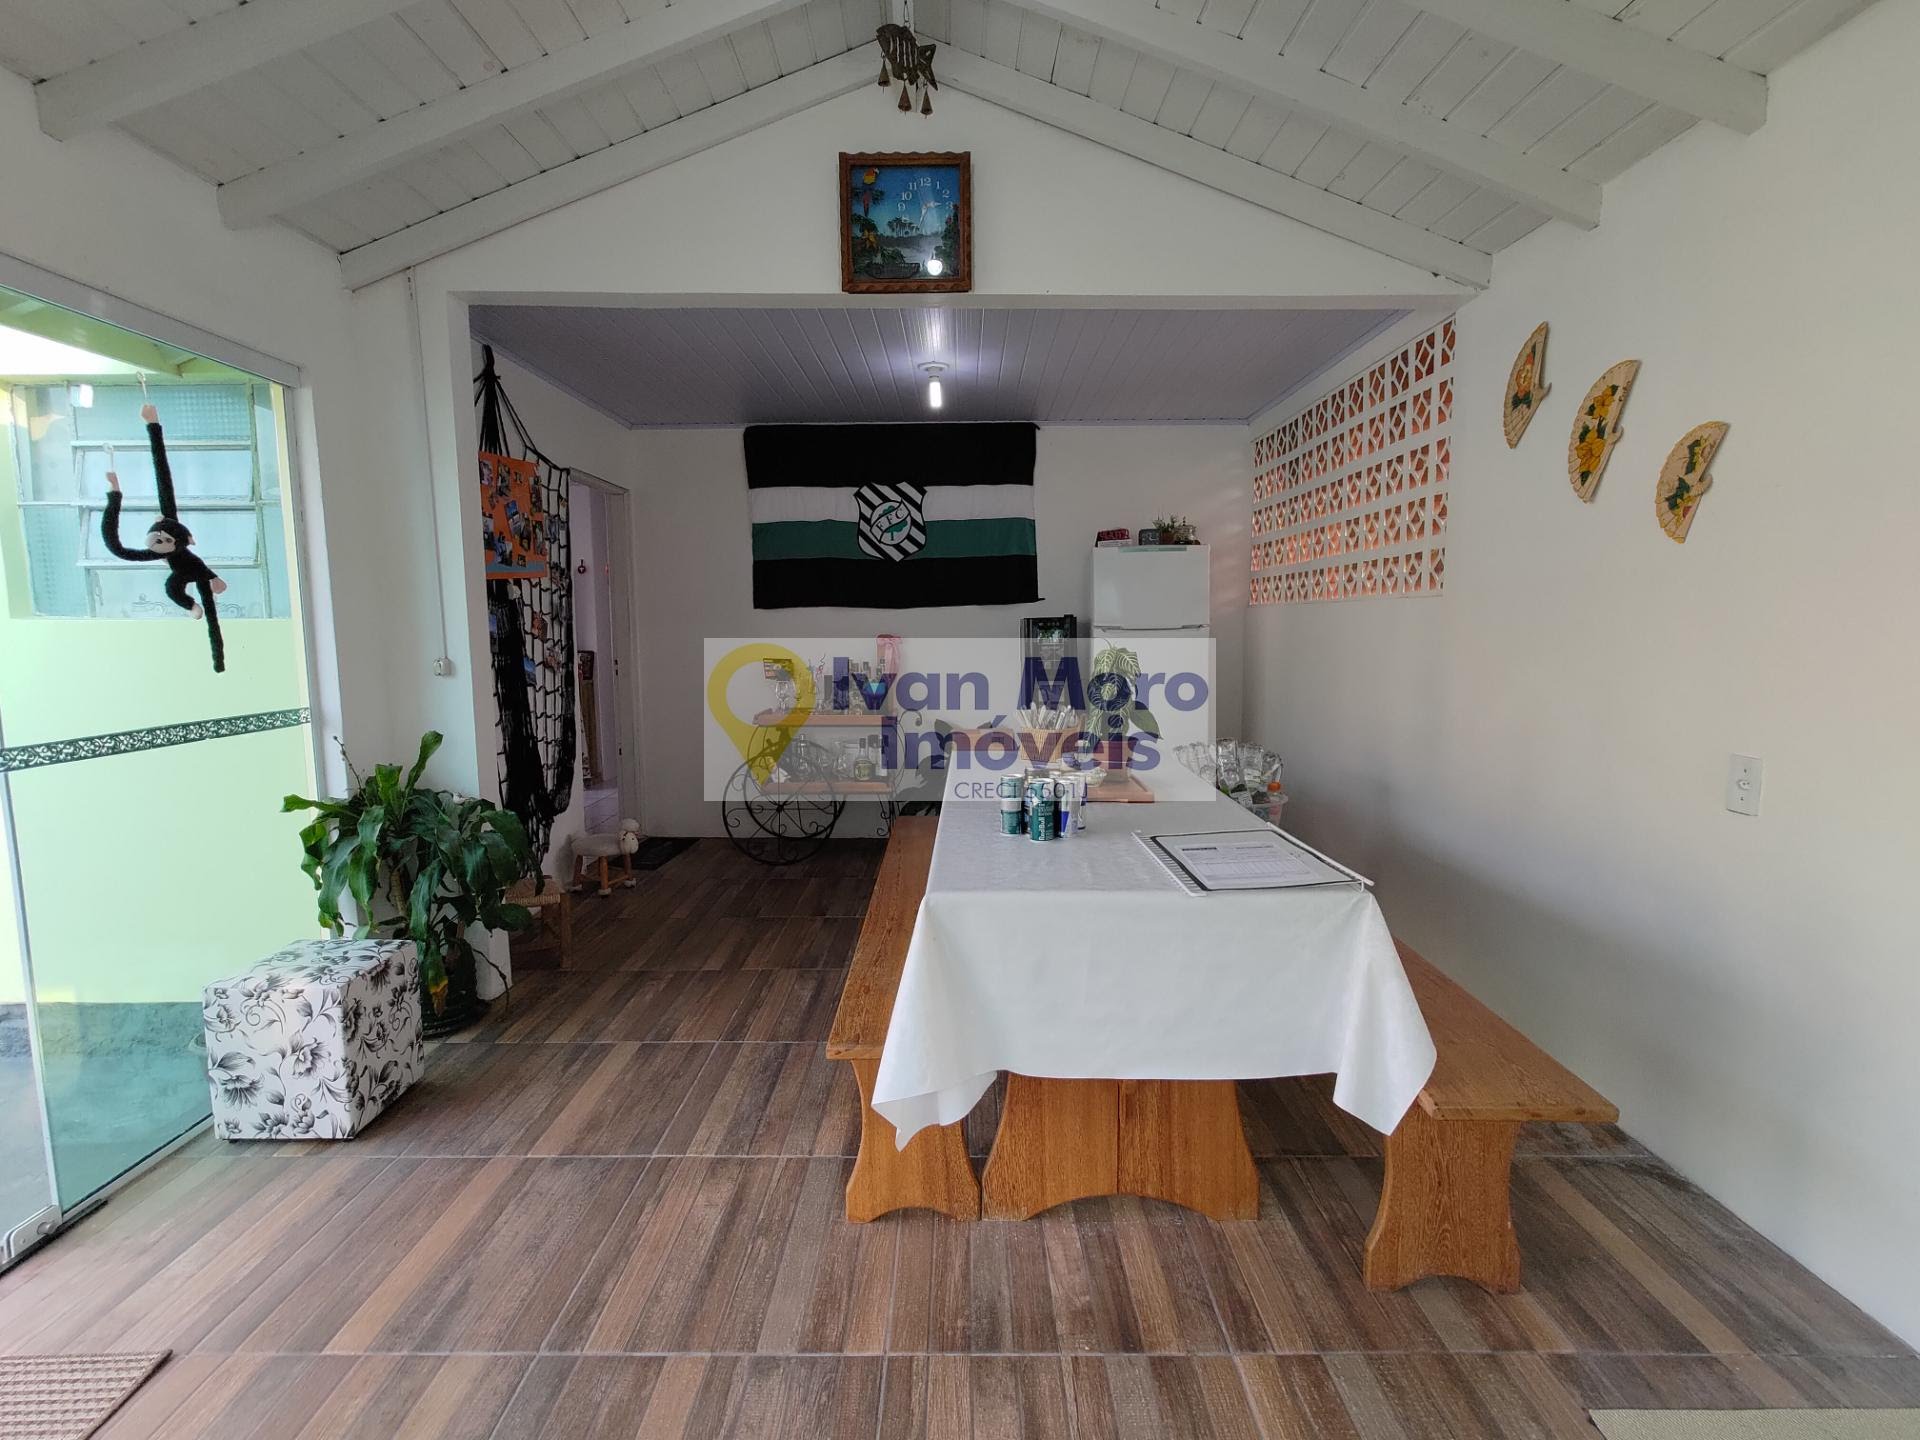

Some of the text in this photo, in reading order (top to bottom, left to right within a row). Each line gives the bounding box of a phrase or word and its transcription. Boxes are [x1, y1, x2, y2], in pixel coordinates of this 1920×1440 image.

[908, 182, 917, 190] 11
[920, 177, 931, 187] 12
[901, 191, 912, 200] 10
[942, 189, 950, 198] 2
[898, 202, 905, 212] 9
